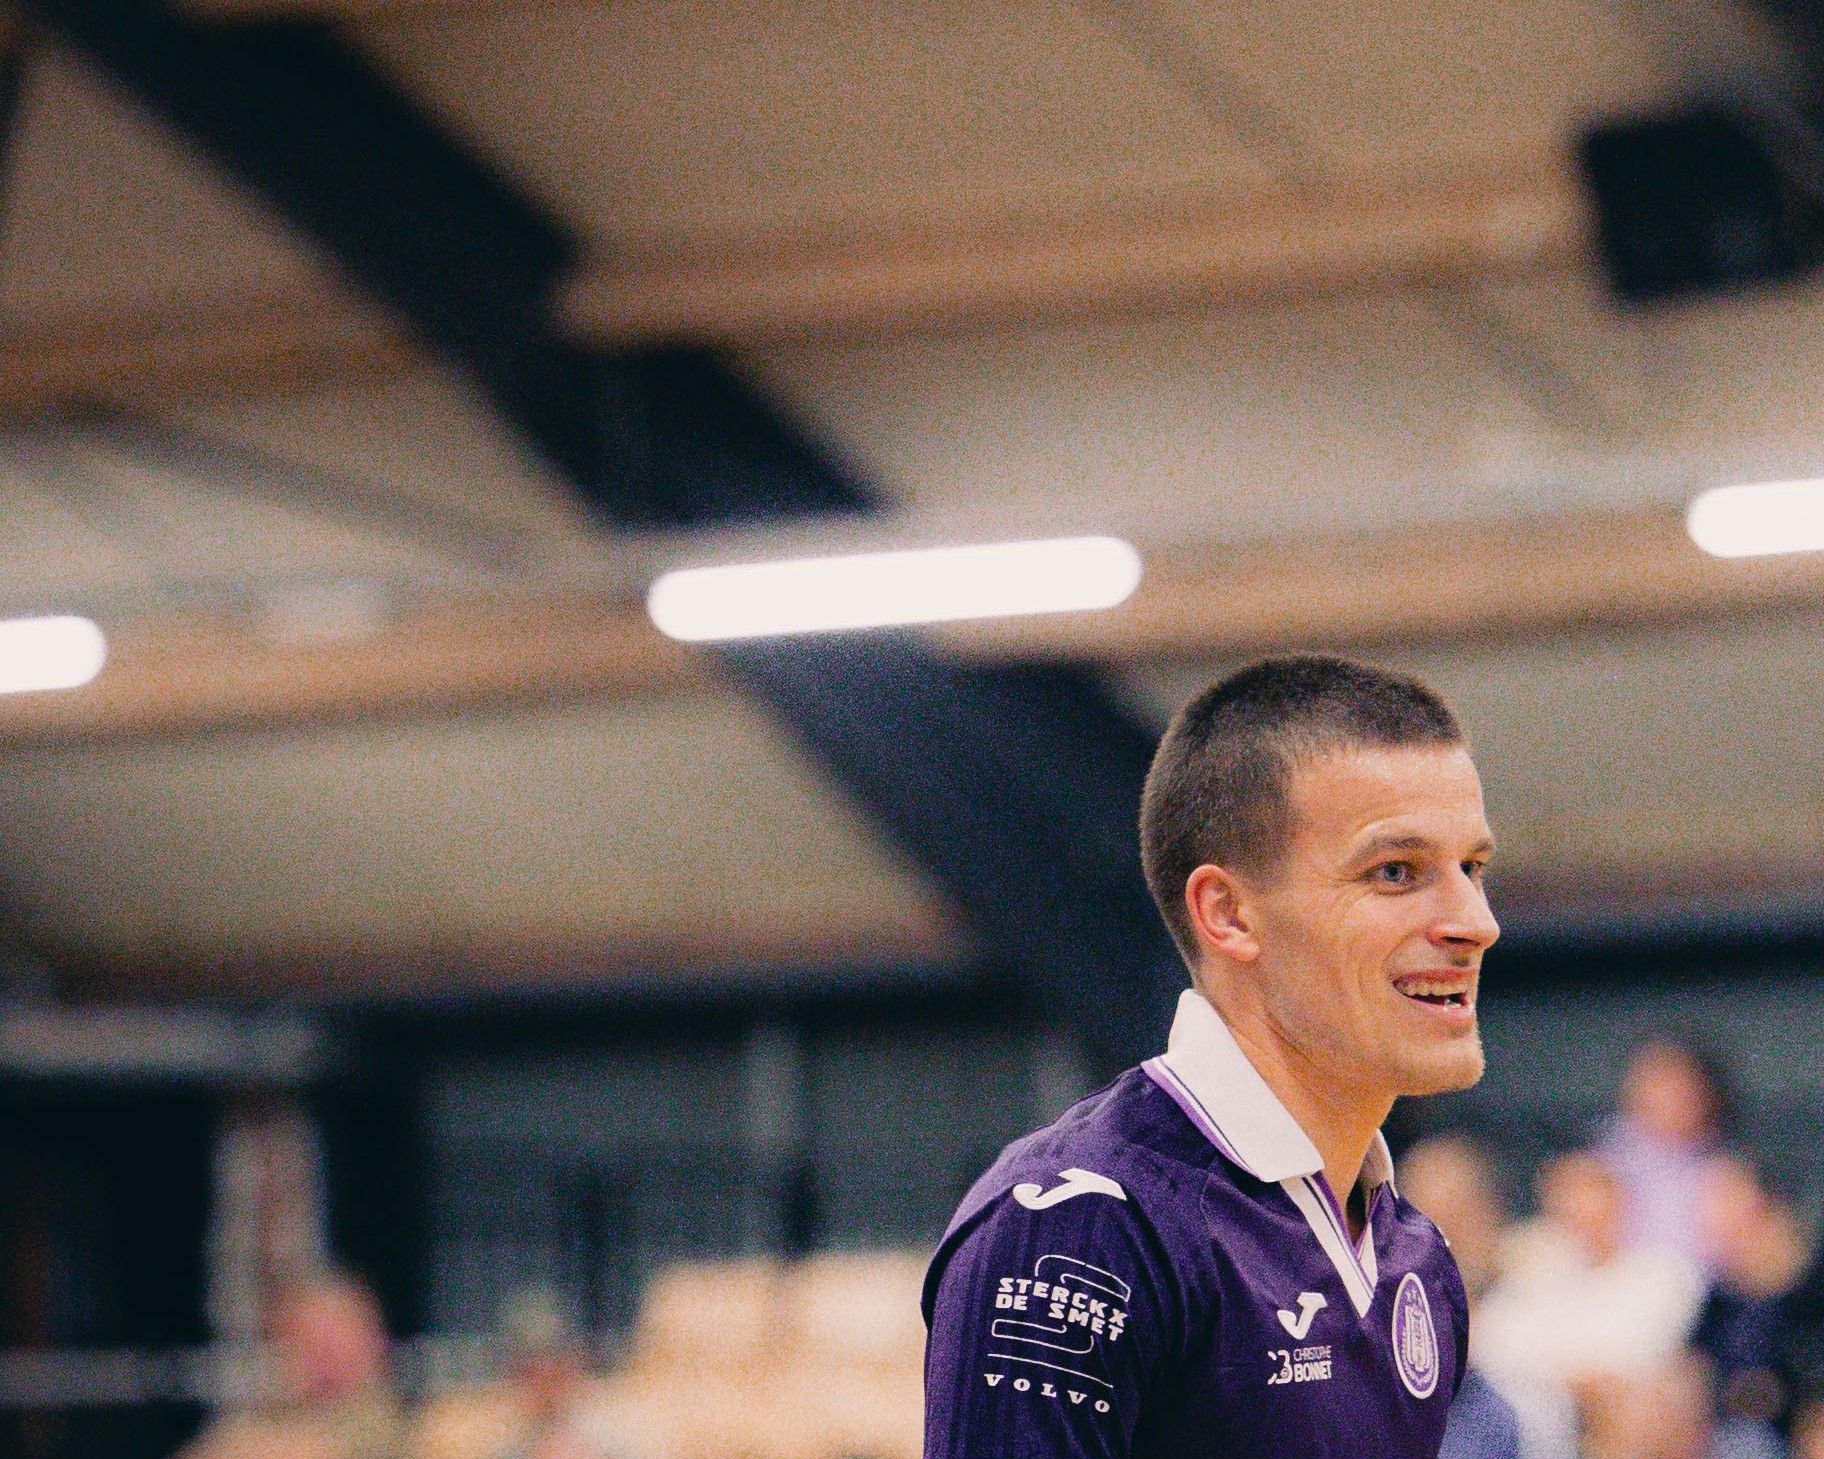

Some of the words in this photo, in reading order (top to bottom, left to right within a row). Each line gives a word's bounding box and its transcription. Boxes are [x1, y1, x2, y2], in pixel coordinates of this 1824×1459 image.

[995, 1293, 1029, 1311] DE
[1048, 1303, 1124, 1342] SMET
[998, 1277, 1128, 1328] STERCKX
[984, 1373, 1111, 1413] VOLVO
